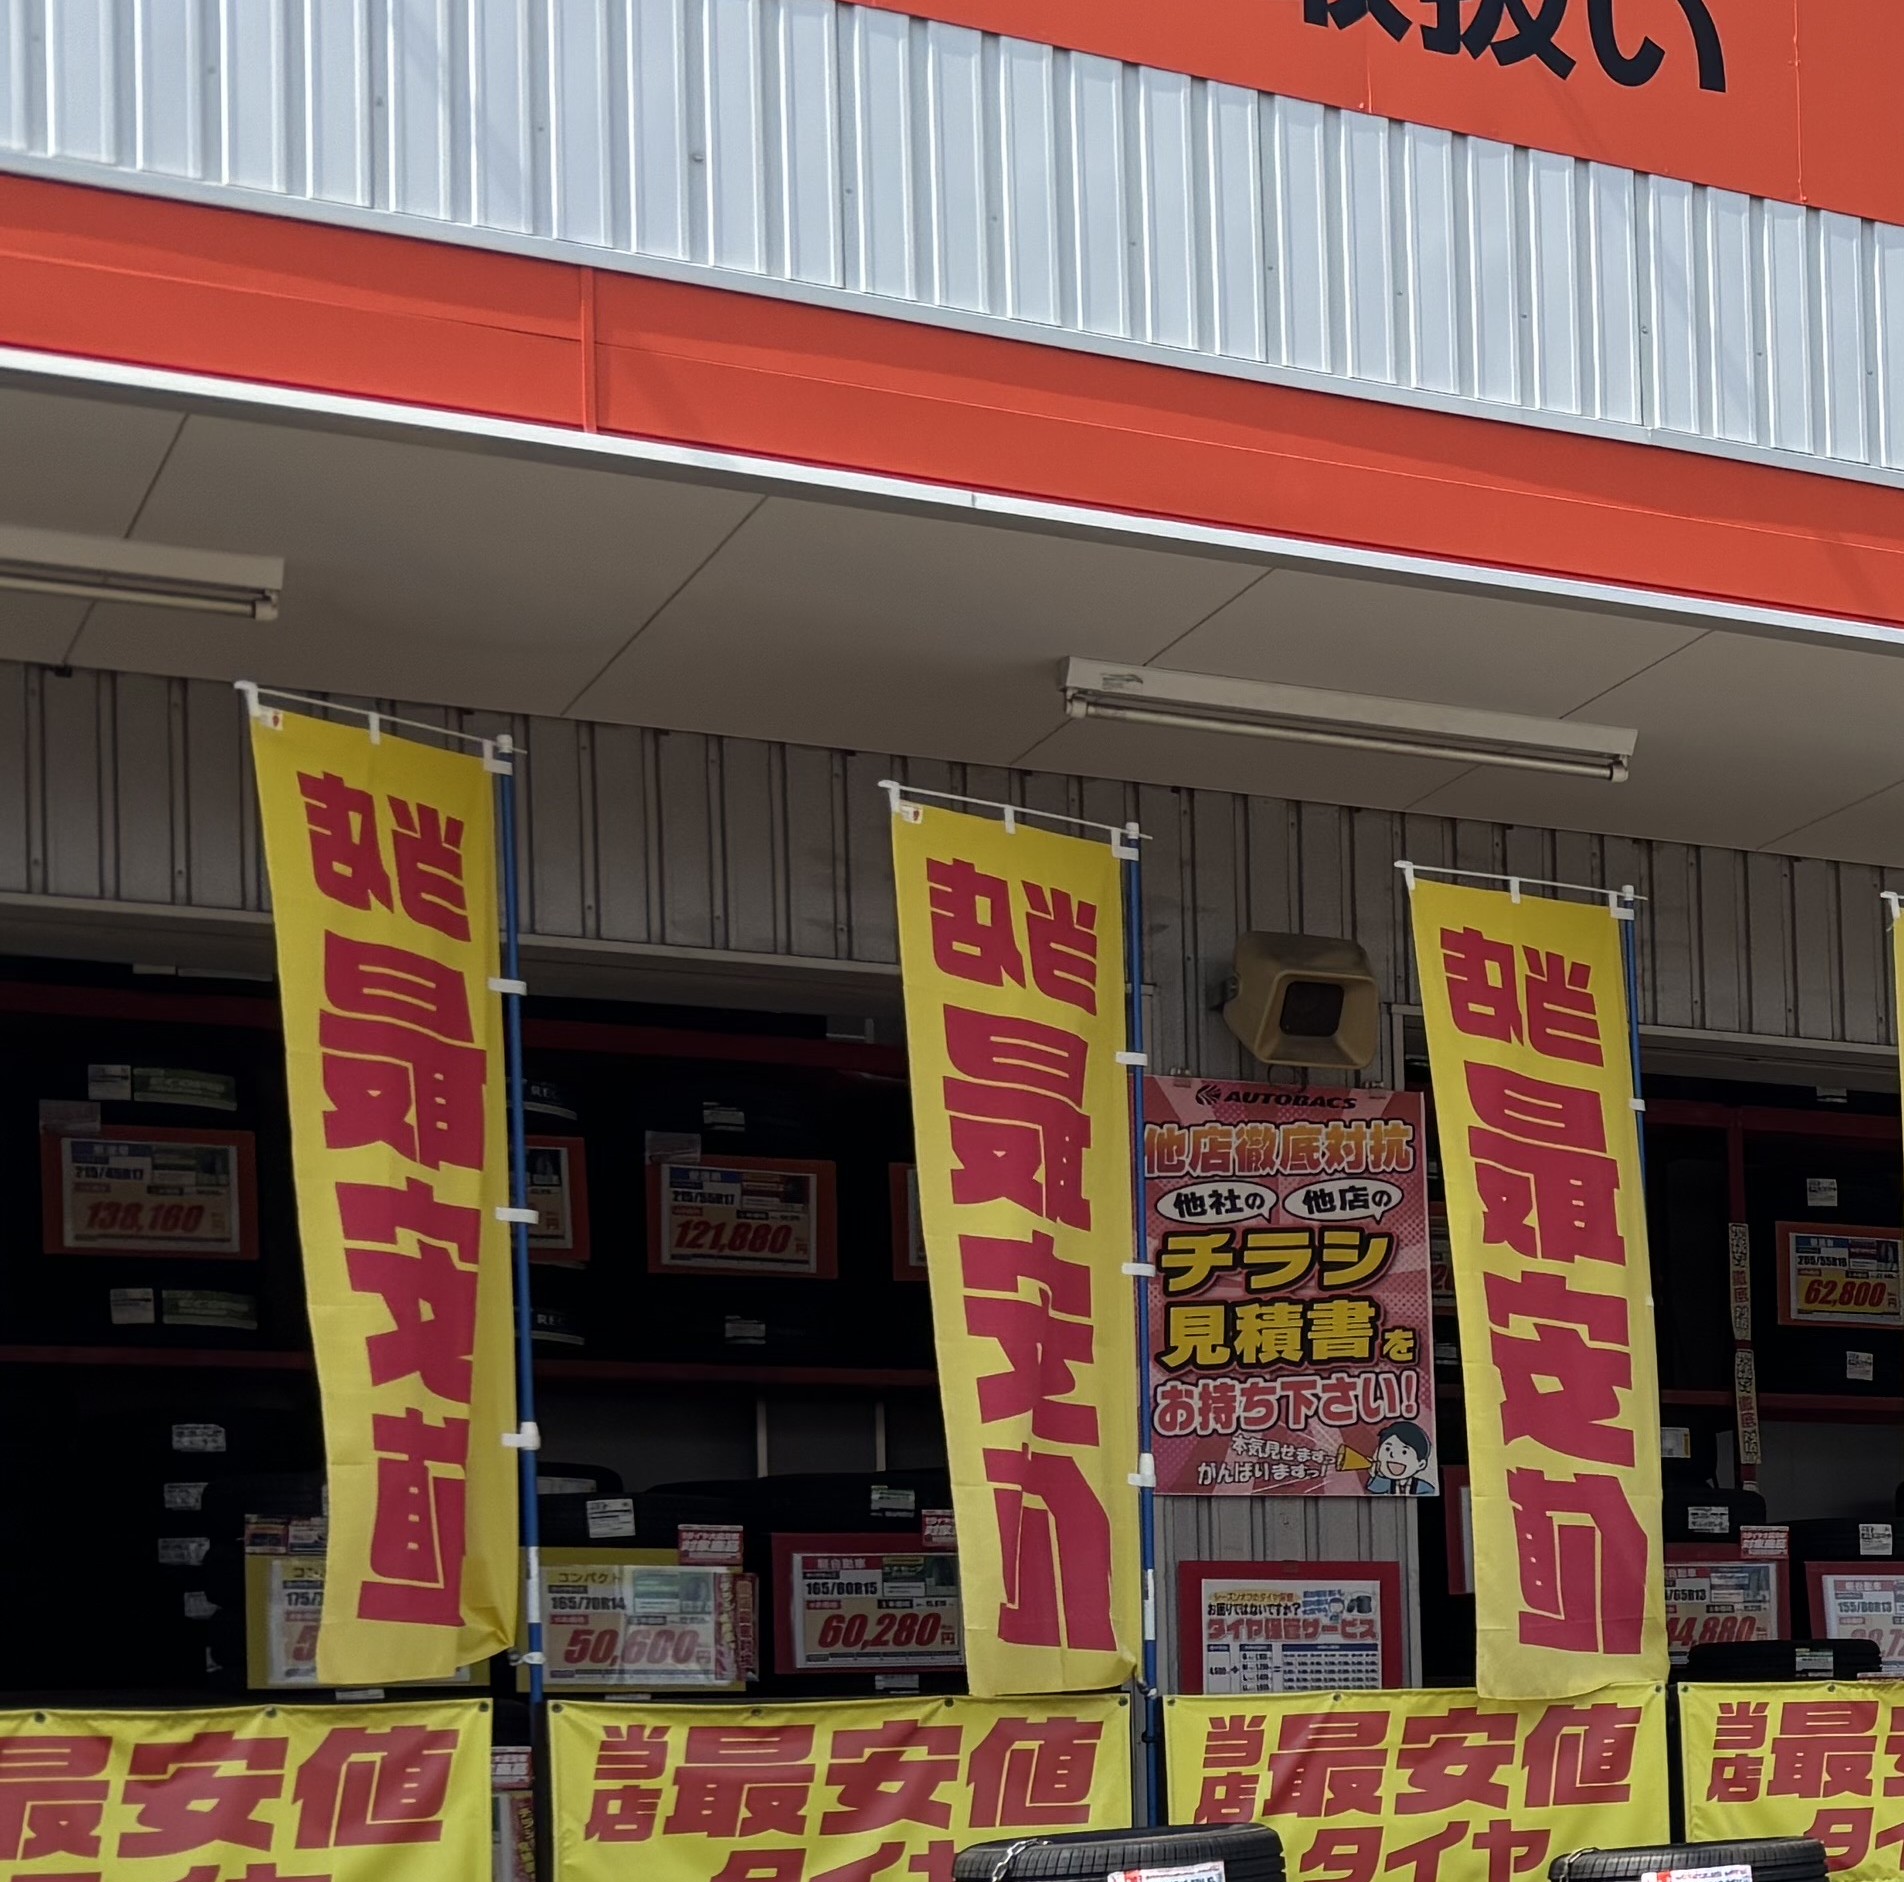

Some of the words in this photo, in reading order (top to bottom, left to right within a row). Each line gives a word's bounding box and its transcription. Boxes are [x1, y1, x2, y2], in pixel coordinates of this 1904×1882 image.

[1224, 1090, 1356, 1109] AUTOBACS
[1144, 1120, 1415, 1177] 他店徹底対抗
[1174, 1191, 1266, 1216] 他社の
[1303, 1186, 1392, 1212] 他店の
[1159, 1228, 1394, 1297] チラシ
[1160, 1300, 1419, 1373] 見積書を
[1154, 1370, 1419, 1436] お持ち下さい!
[665, 1717, 1106, 1838] 最安値
[1265, 1699, 1638, 1818] 最安値
